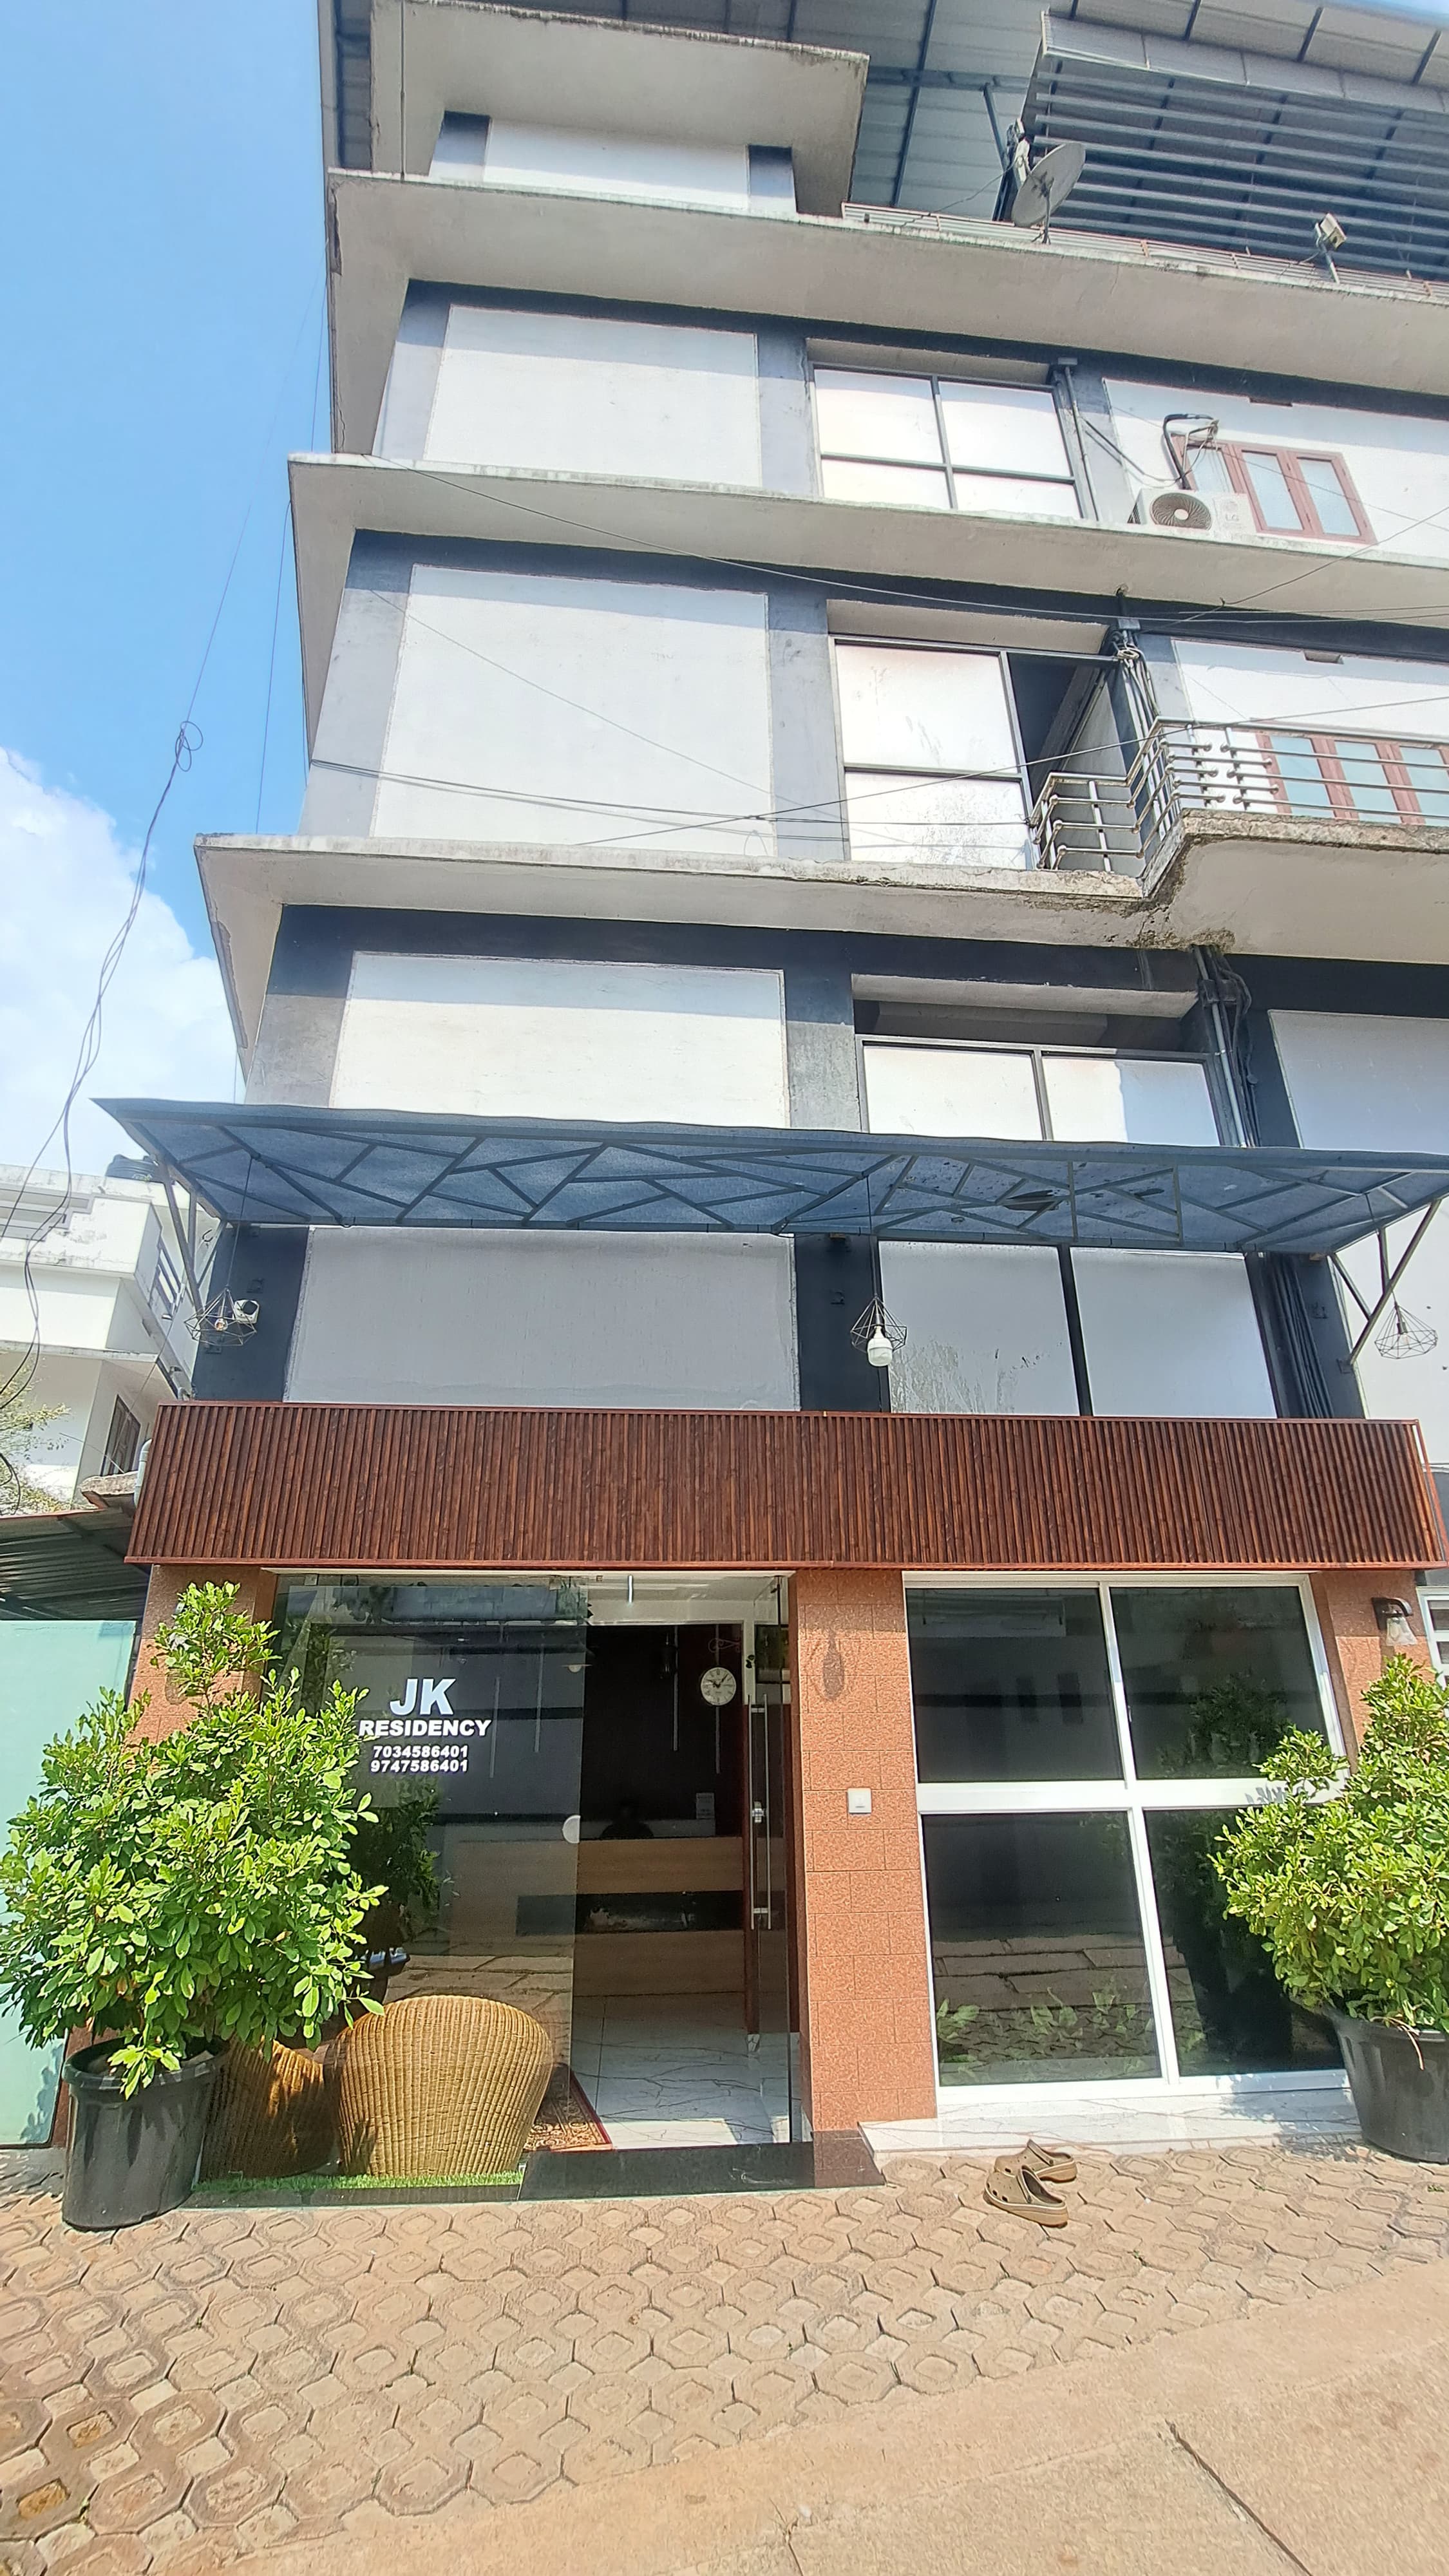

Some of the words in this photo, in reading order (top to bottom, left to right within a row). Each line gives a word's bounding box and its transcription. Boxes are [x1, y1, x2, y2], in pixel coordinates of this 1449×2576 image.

[390, 1678, 456, 1715] JK
[359, 1720, 491, 1736] RESIDENCY
[373, 1746, 469, 1758] 7034586401
[370, 1759, 469, 1772] 9747586401
